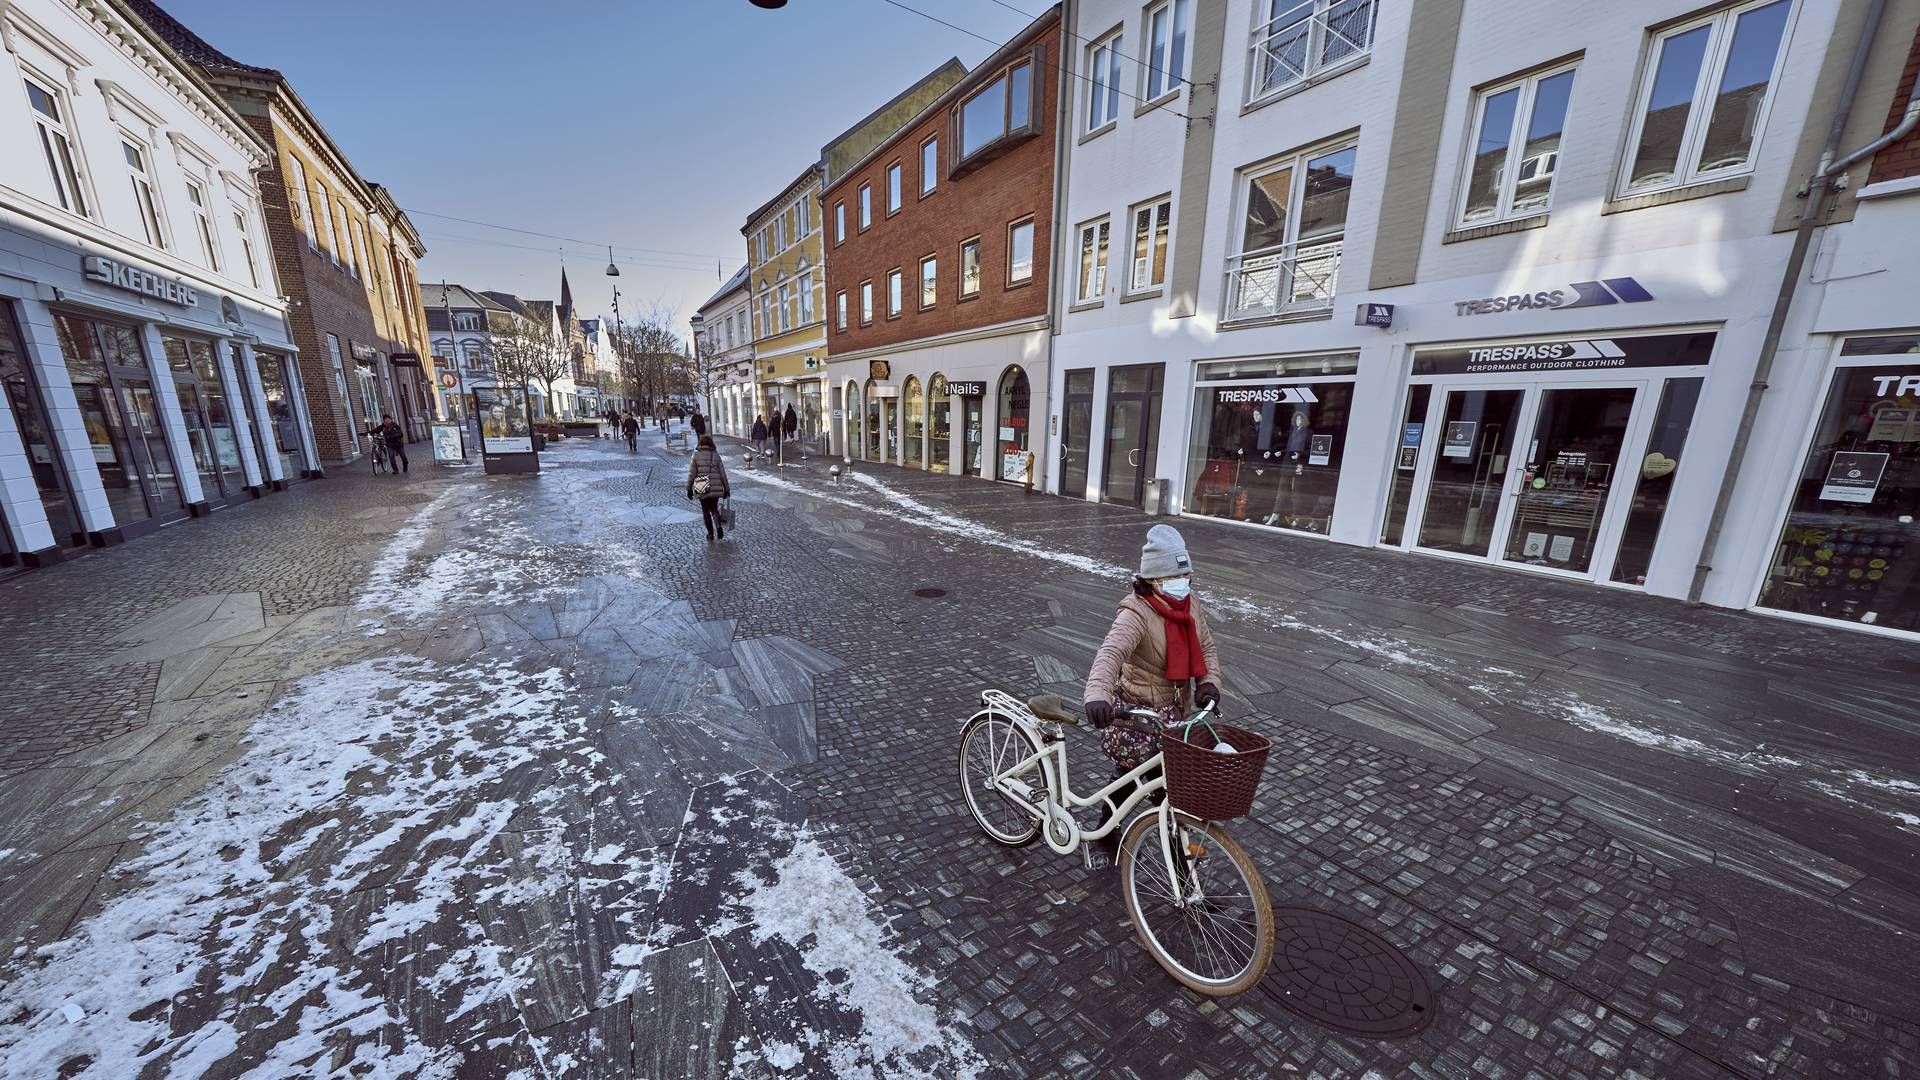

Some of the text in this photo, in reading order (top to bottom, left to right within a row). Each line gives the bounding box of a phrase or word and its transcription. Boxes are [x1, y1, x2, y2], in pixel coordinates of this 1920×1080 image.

[86, 256, 199, 307] SKECHERS
[1455, 289, 1564, 316] TRESPASS
[1368, 315, 1391, 323] TRESPASS
[1469, 345, 1563, 362] TRESPASS
[1467, 358, 1625, 372] PERFORMANCE OUTDOOR CLOTHING
[1219, 389, 1279, 402] TRESPASS
